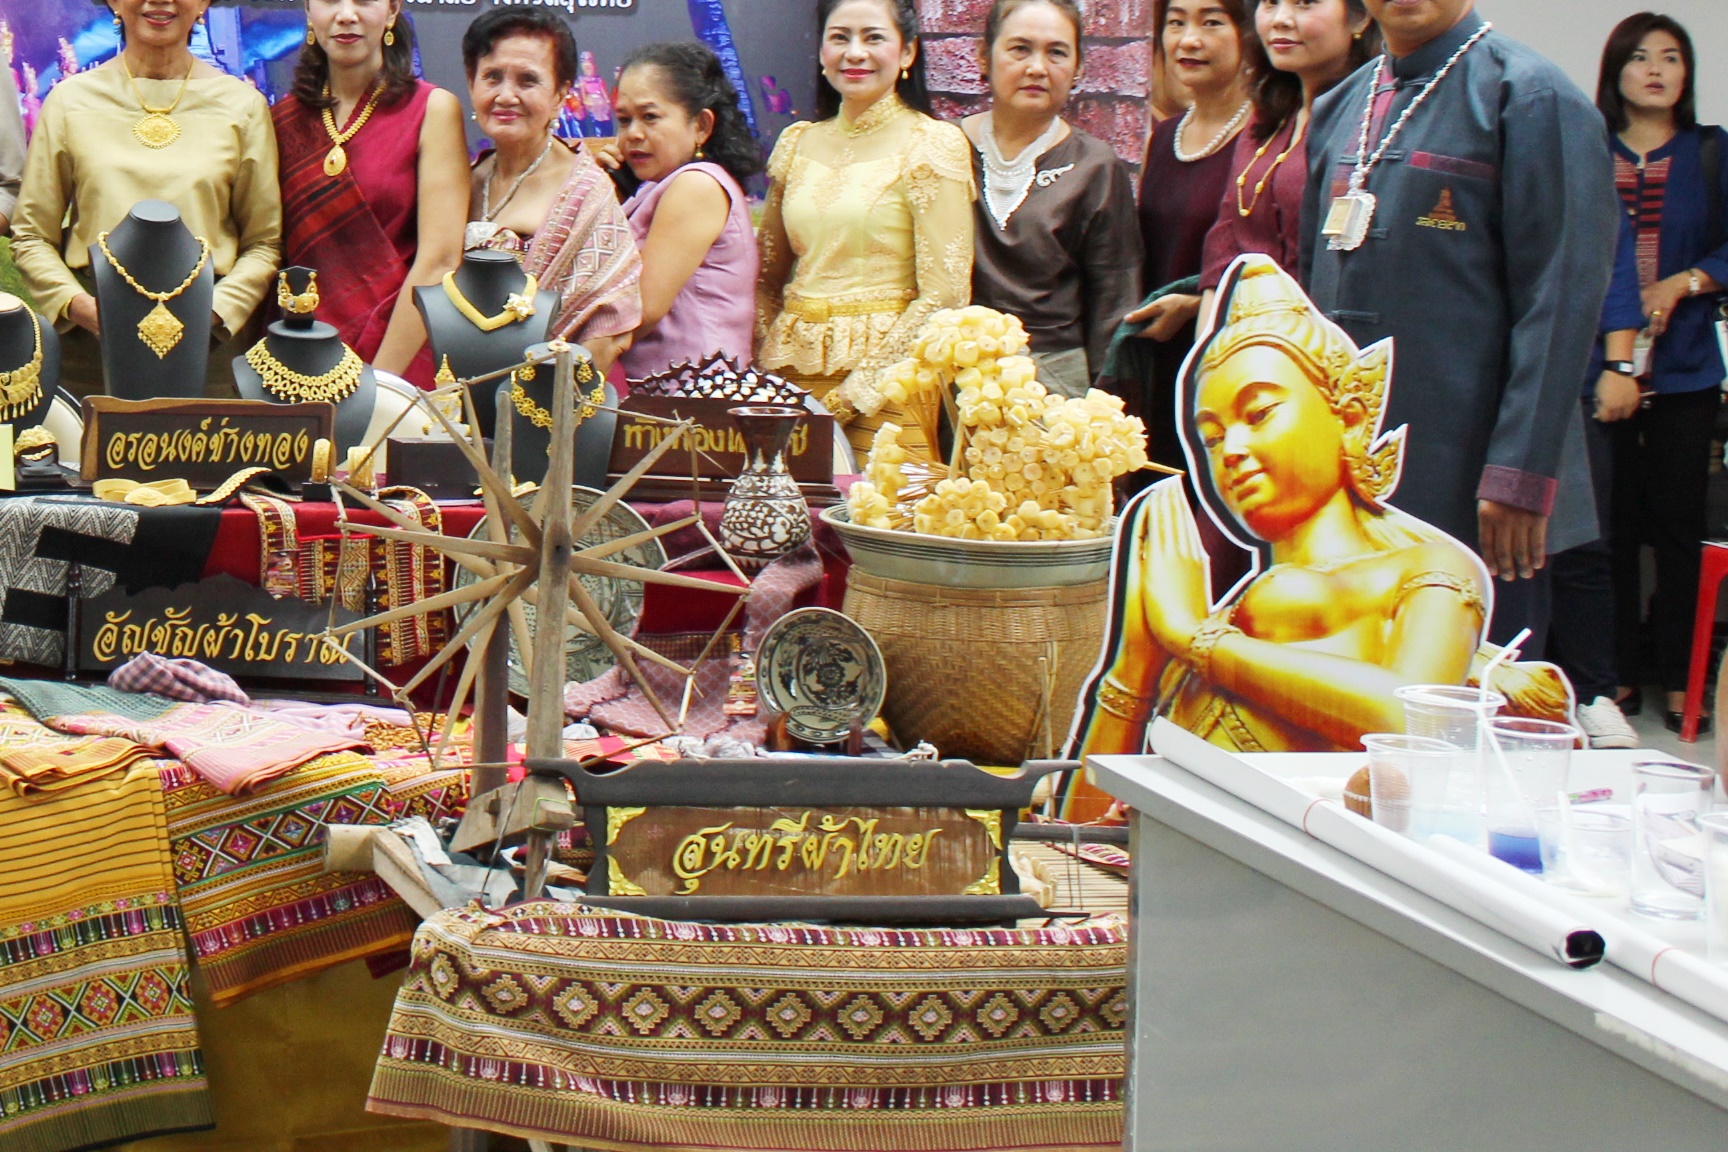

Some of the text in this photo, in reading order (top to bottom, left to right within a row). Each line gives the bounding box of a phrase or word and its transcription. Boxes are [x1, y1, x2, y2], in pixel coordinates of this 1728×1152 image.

[105, 417, 311, 471] อรอนงค์ช่างทอง
[673, 811, 944, 896] สุนทรีผ้าไทย
